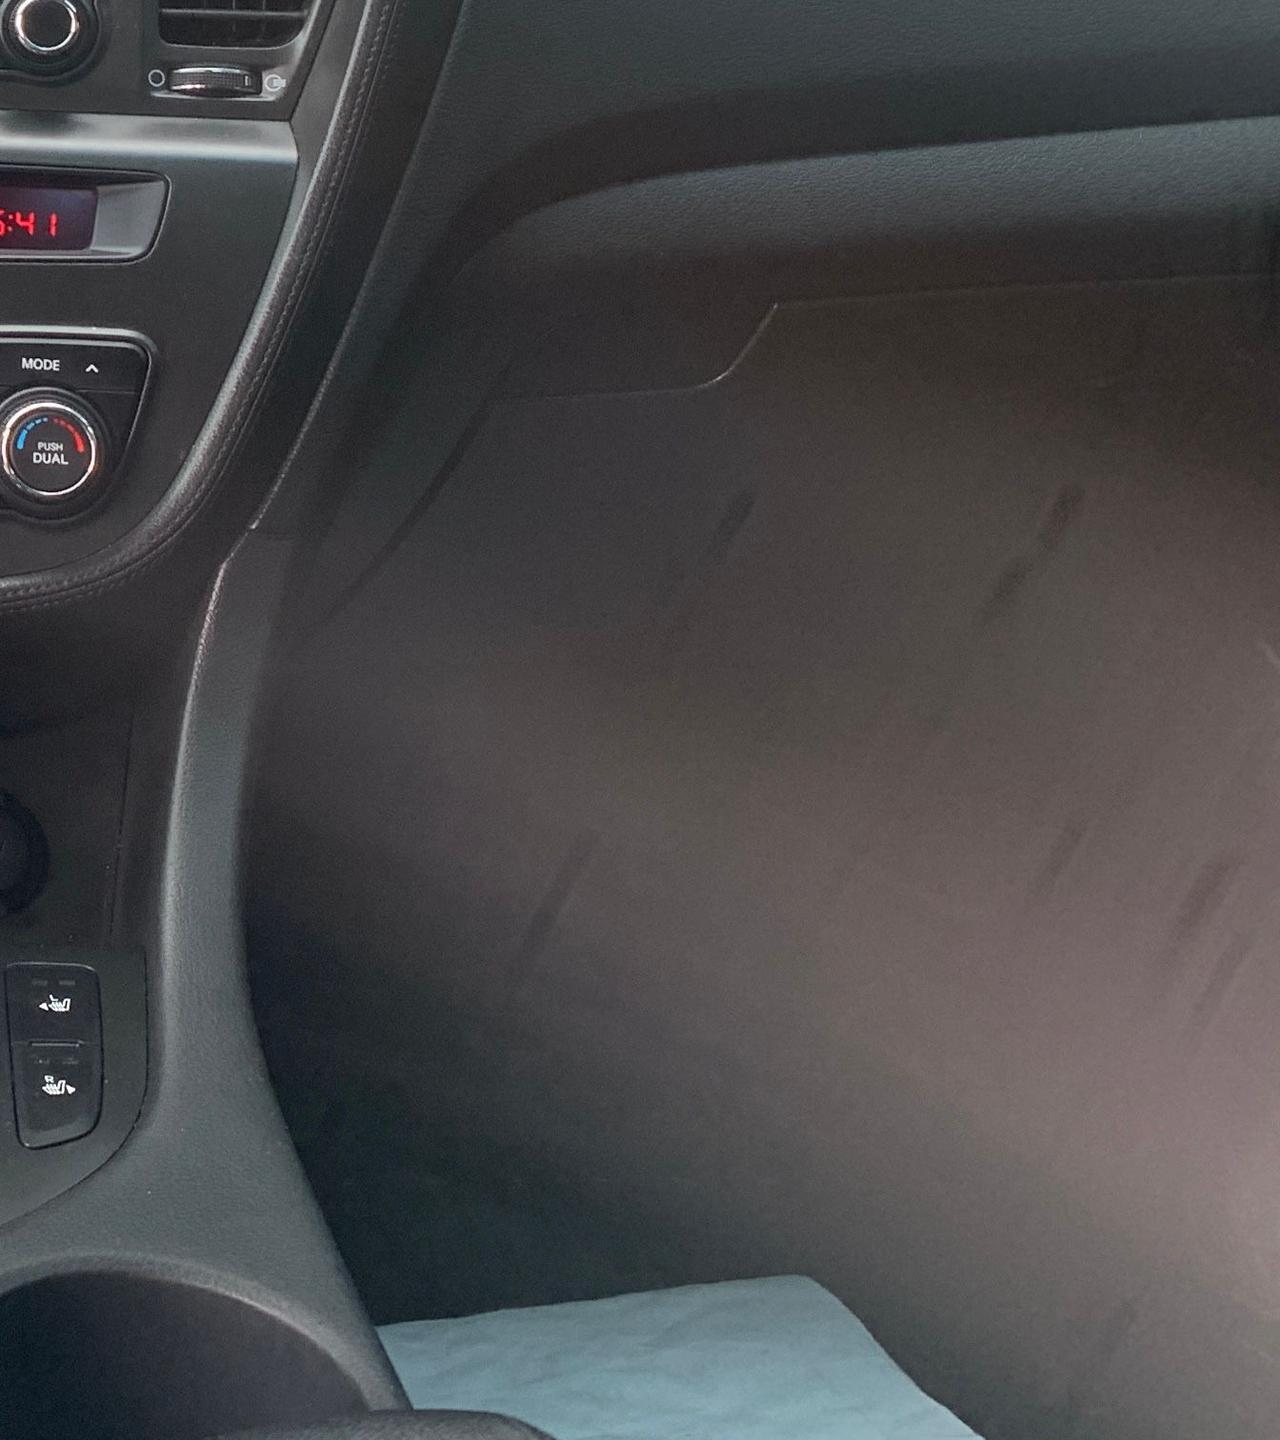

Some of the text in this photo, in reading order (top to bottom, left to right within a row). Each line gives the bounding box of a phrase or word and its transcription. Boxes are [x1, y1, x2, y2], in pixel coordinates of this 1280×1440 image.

[21, 357, 60, 372] MODE
[38, 442, 64, 452] PUSH
[32, 451, 69, 466] DUAL
